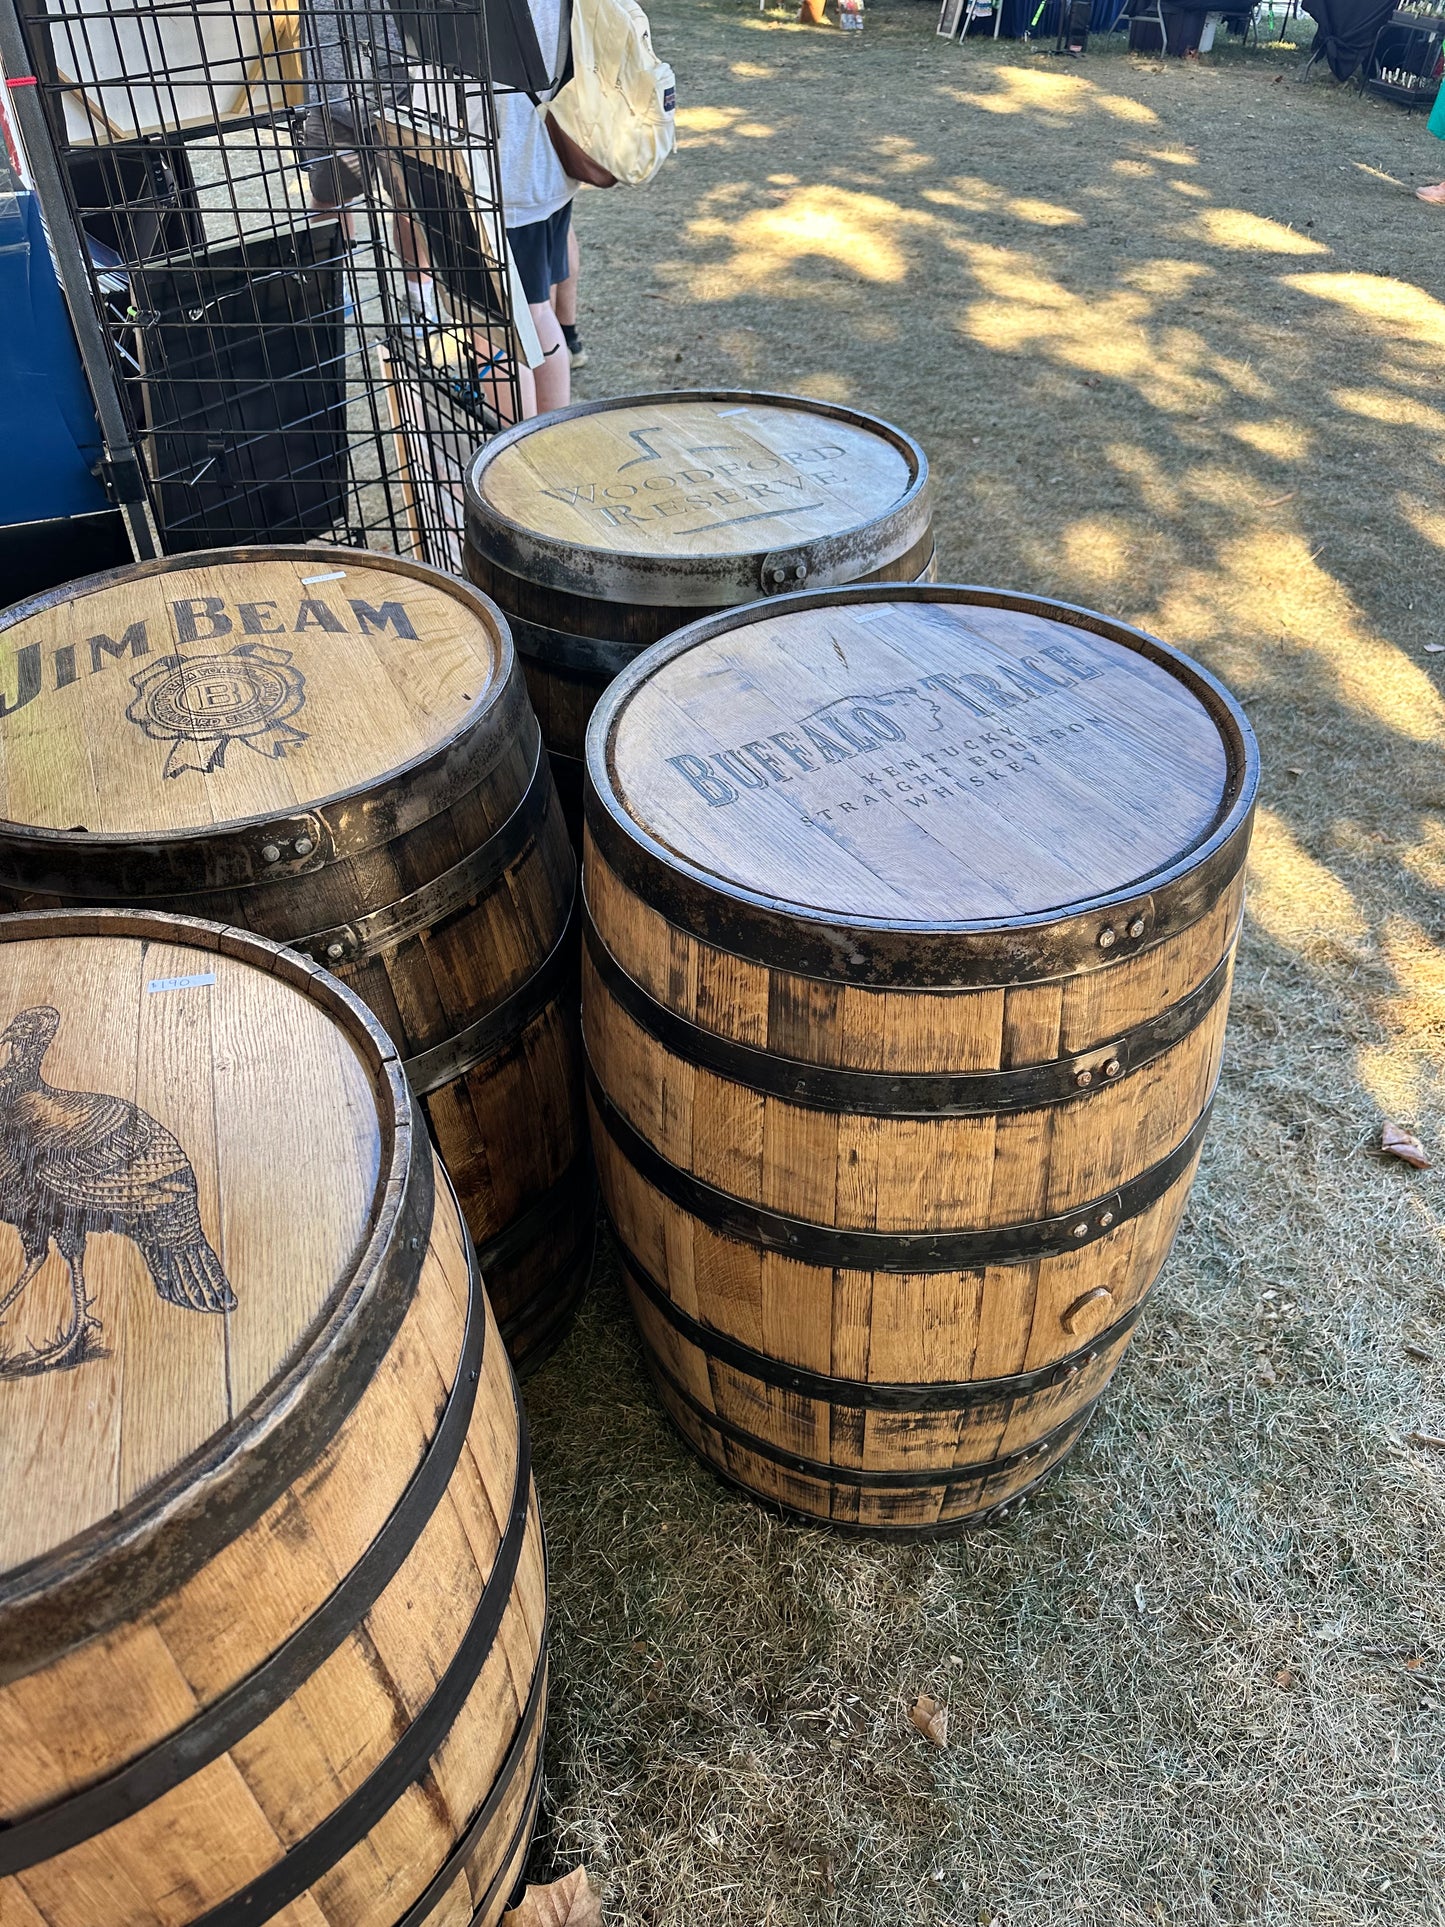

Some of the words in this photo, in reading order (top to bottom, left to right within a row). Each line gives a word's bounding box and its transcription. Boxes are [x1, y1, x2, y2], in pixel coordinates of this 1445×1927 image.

[537, 446, 847, 506] WOODFORD
[592, 470, 848, 528] RESERVE
[0, 618, 155, 718] JIM
[165, 597, 423, 645] BEAM
[194, 681, 242, 710] B
[664, 707, 907, 809] BUFFALO
[917, 645, 1105, 718] TRACE
[861, 725, 1017, 785] KENTUCKY
[800, 767, 955, 827] STRAIGHT
[906, 754, 1042, 808] WHISKEY
